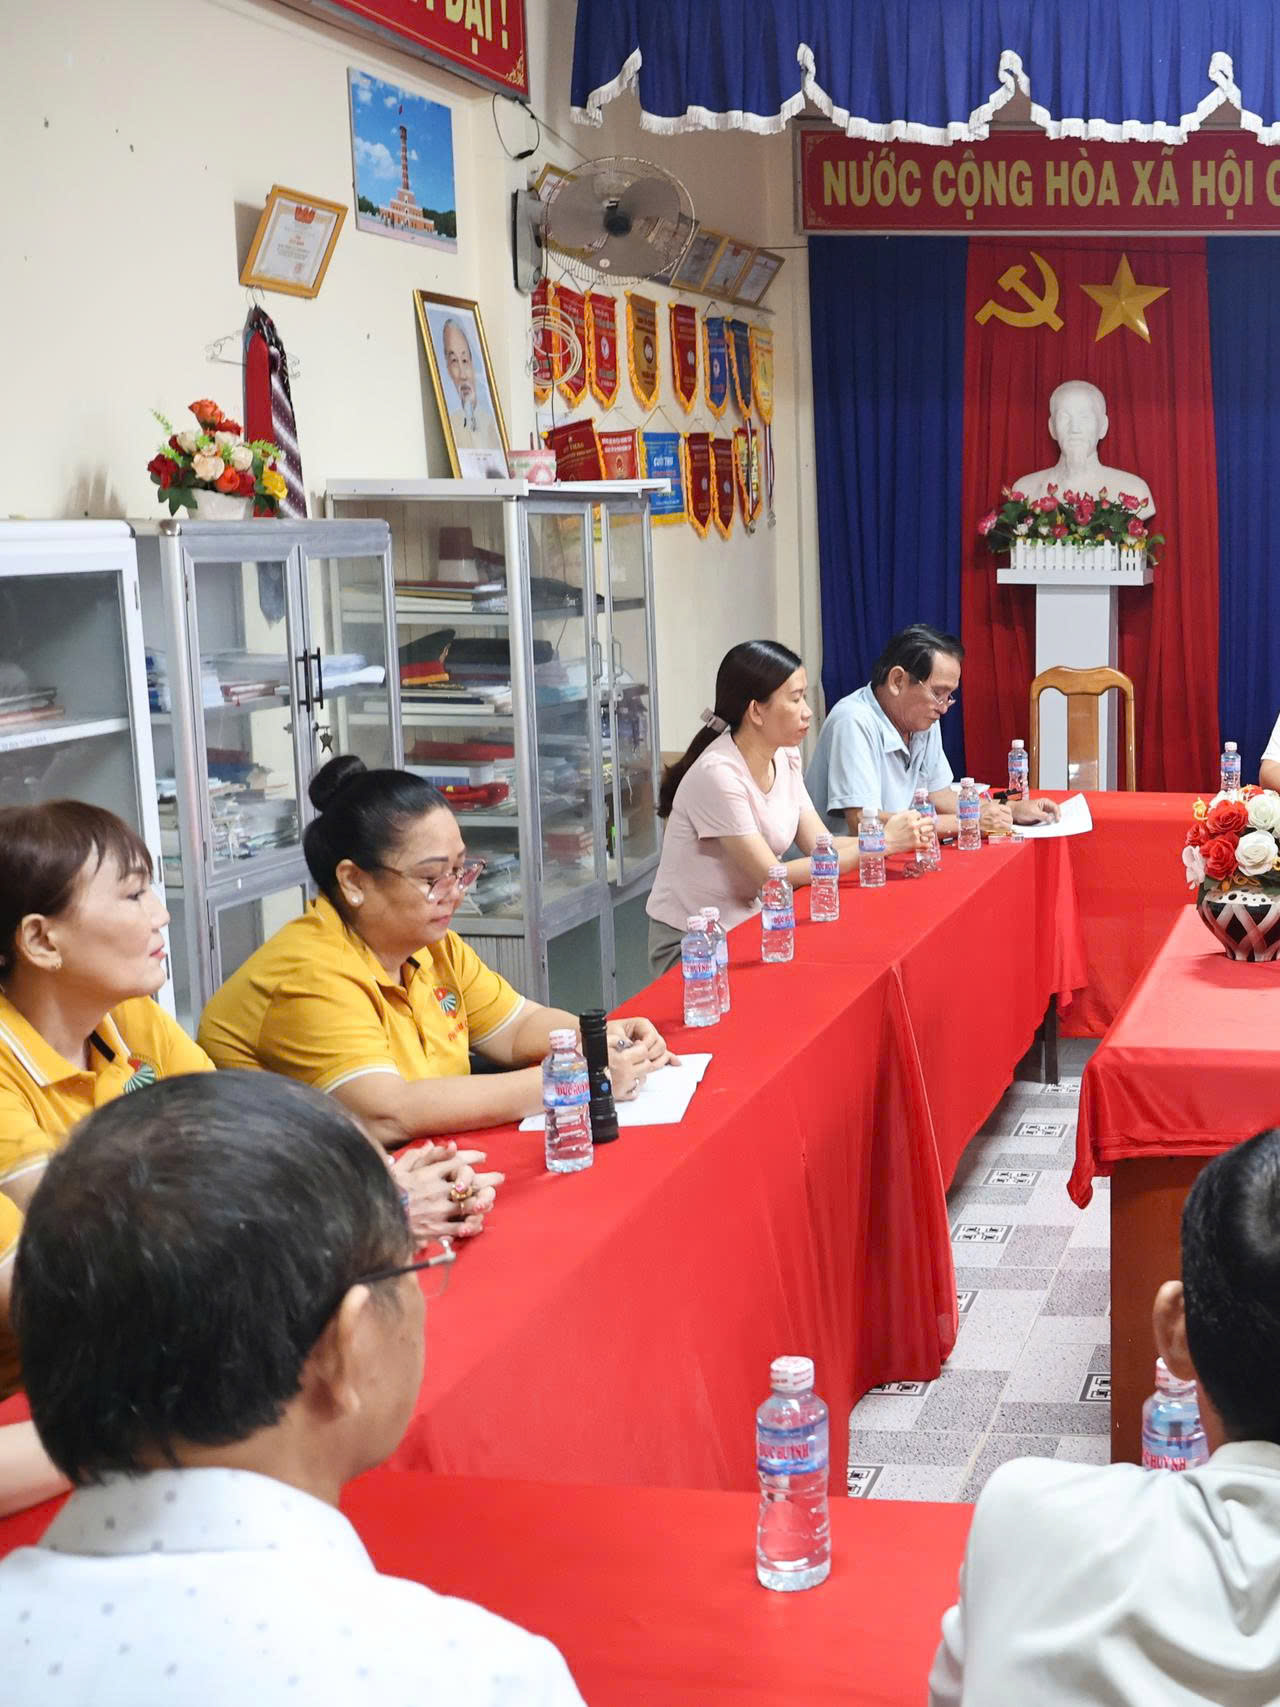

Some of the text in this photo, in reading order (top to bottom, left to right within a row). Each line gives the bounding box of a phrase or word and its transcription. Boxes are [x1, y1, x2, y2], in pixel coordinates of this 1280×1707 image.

[823, 151, 921, 207] NƯỚC
[933, 149, 1033, 220] CỘNG
[1046, 147, 1120, 207] HÒA
[1131, 146, 1180, 207] XÃ
[1192, 149, 1254, 220] HỘI
